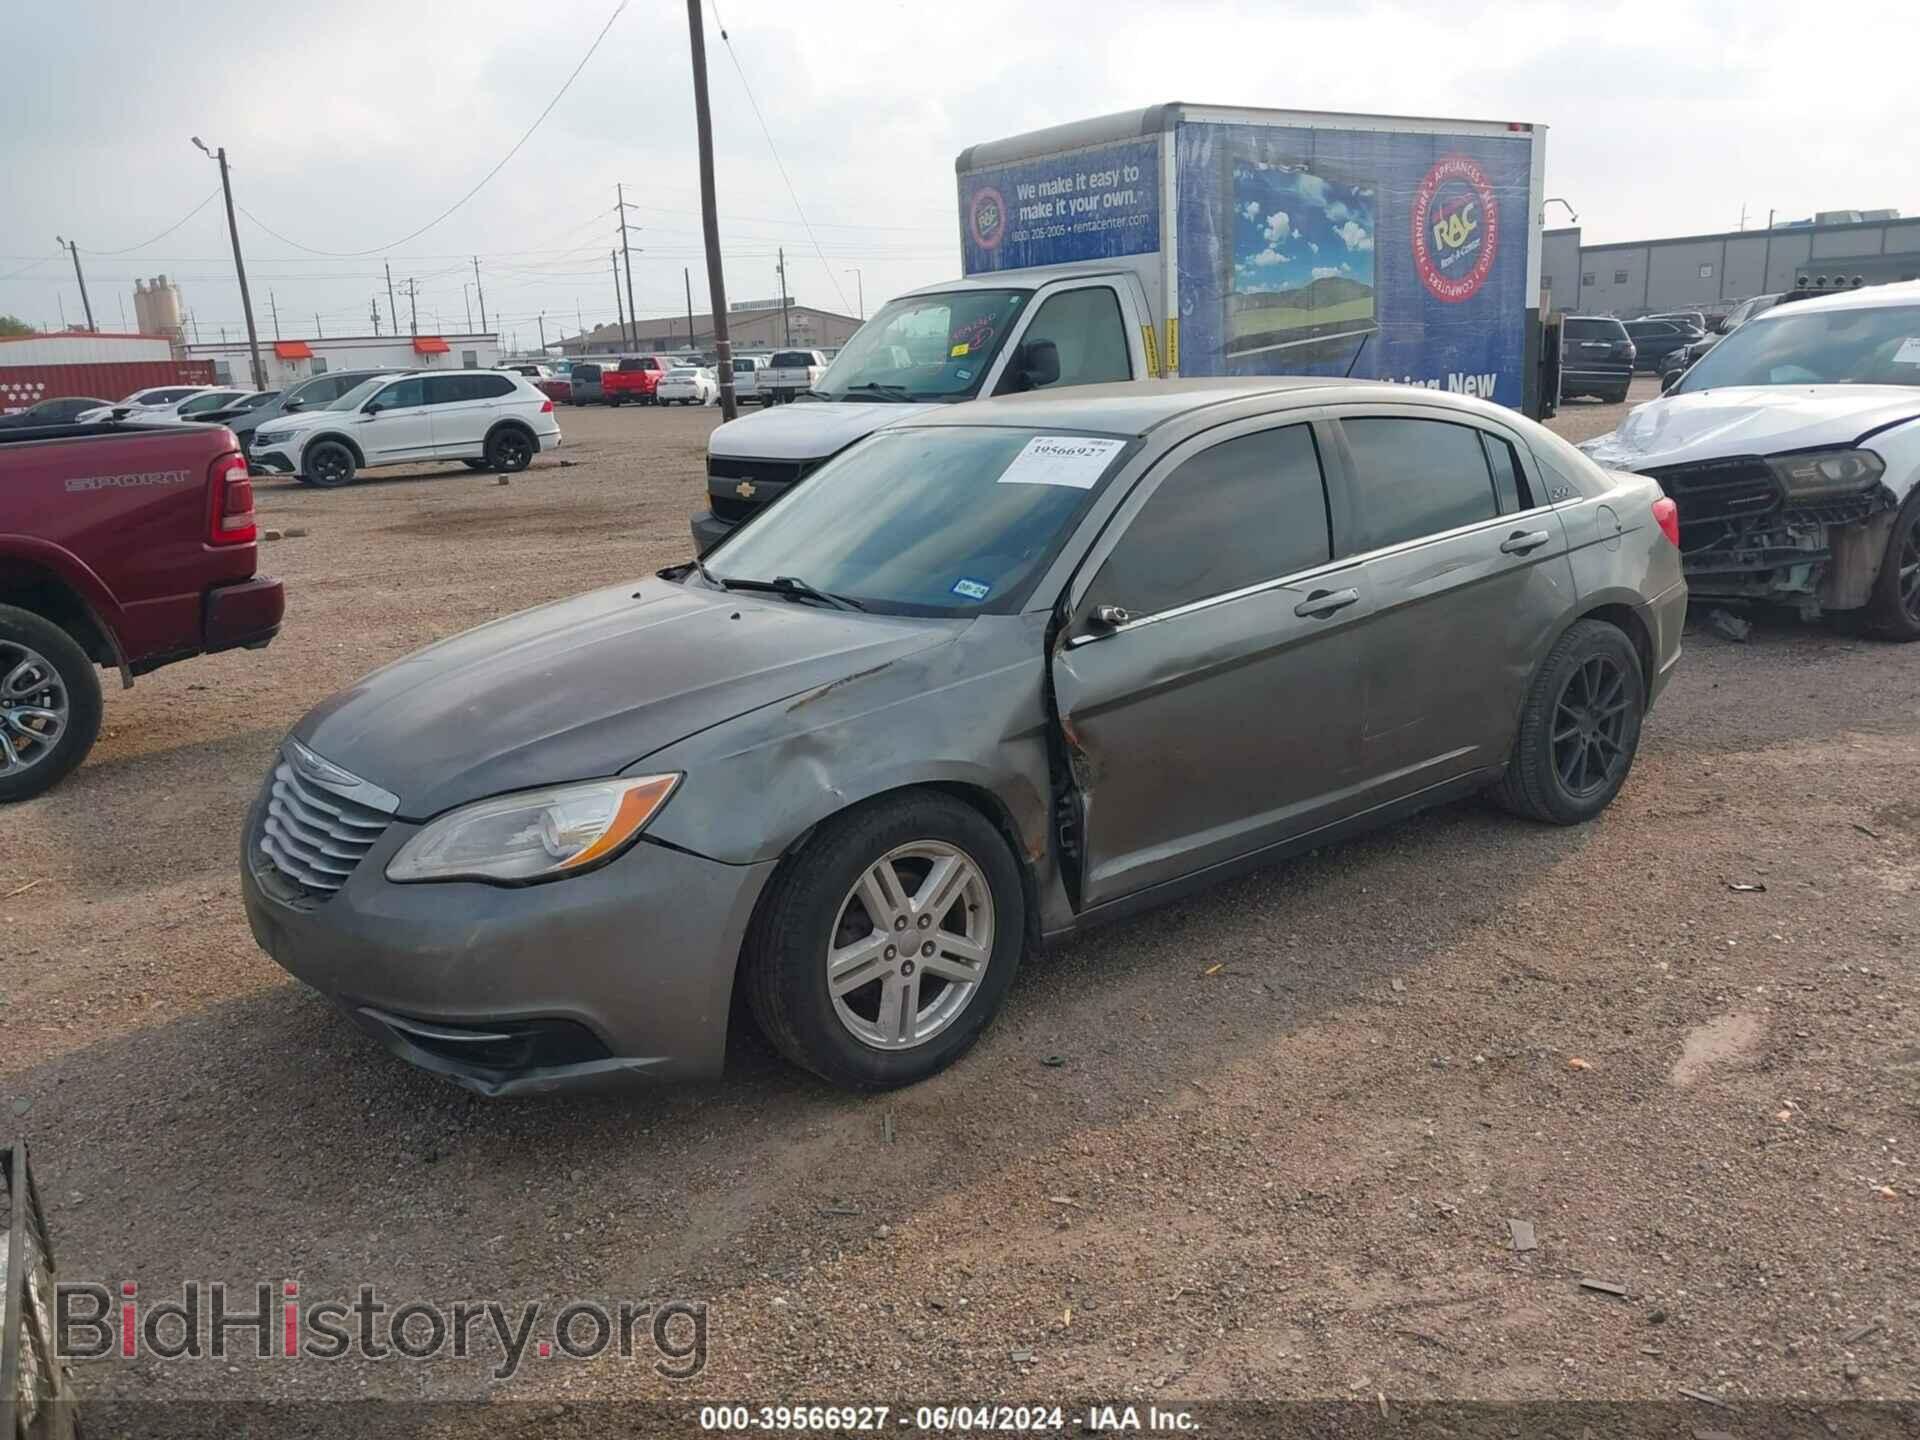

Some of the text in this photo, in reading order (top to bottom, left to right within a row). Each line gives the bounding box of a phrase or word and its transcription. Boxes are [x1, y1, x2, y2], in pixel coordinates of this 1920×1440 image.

[1016, 165, 1139, 200] We make it easy to
[1020, 201, 1053, 221] make
[1056, 198, 1067, 216] it
[1069, 194, 1100, 216] your
[1072, 213, 1150, 233] rentacenter.com
[1448, 372, 1498, 399] New
[65, 470, 191, 492] SPORT
